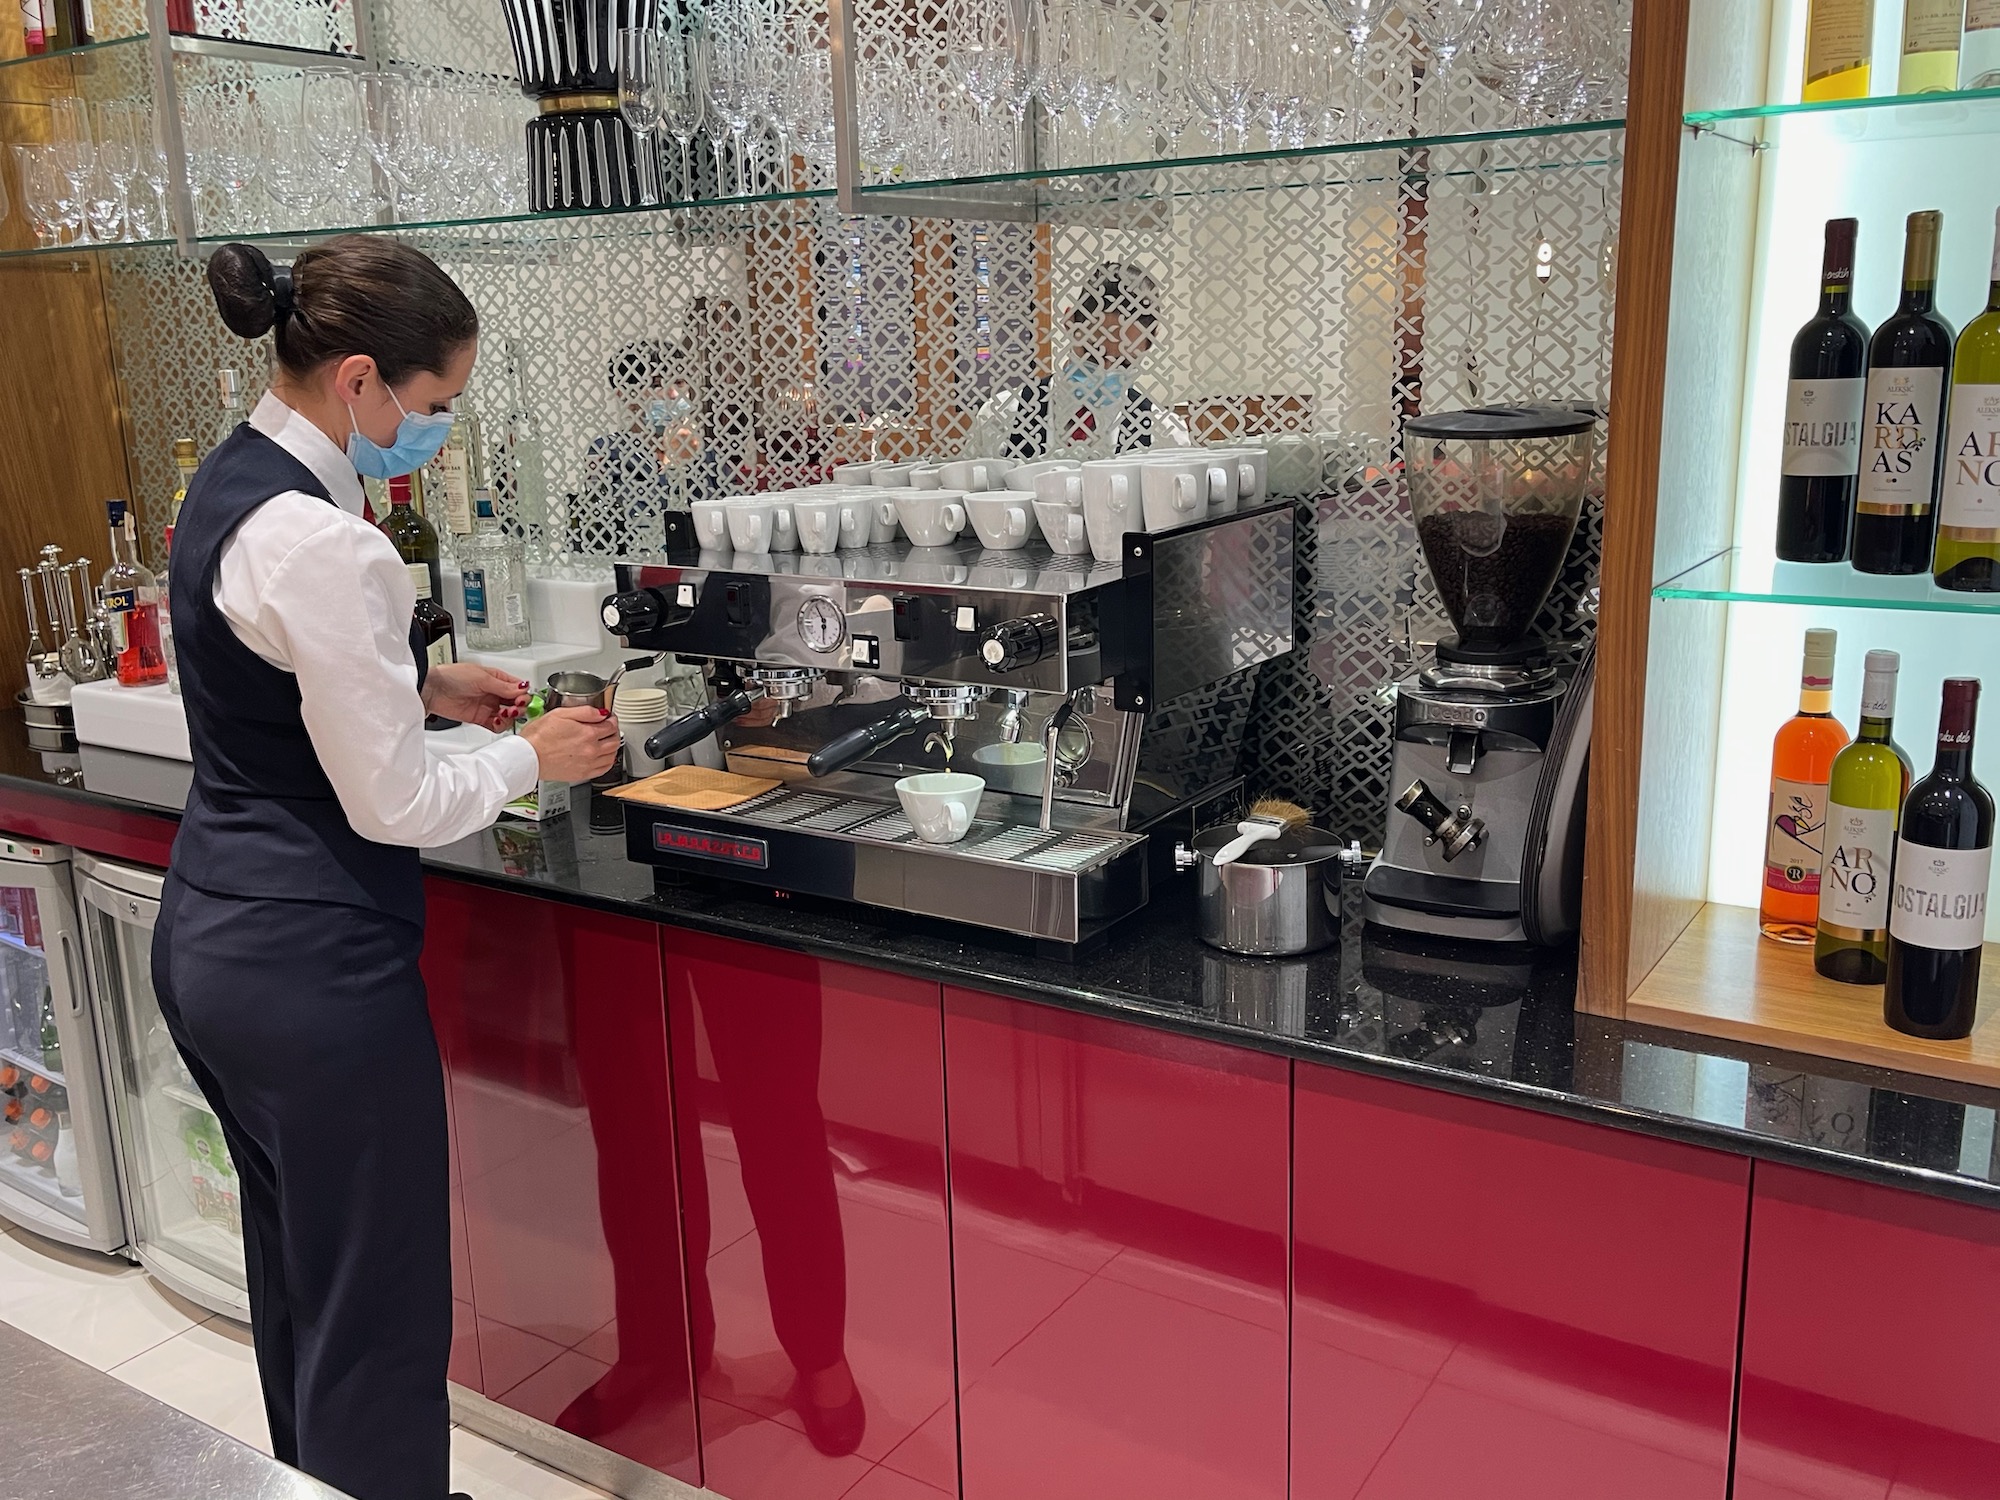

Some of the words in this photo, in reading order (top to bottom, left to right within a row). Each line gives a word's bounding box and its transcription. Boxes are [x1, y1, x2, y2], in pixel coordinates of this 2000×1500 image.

[1875, 402, 1922, 426] KA
[1871, 450, 1913, 474] AS
[1831, 845, 1873, 874] AR
[1829, 866, 1876, 895] NO
